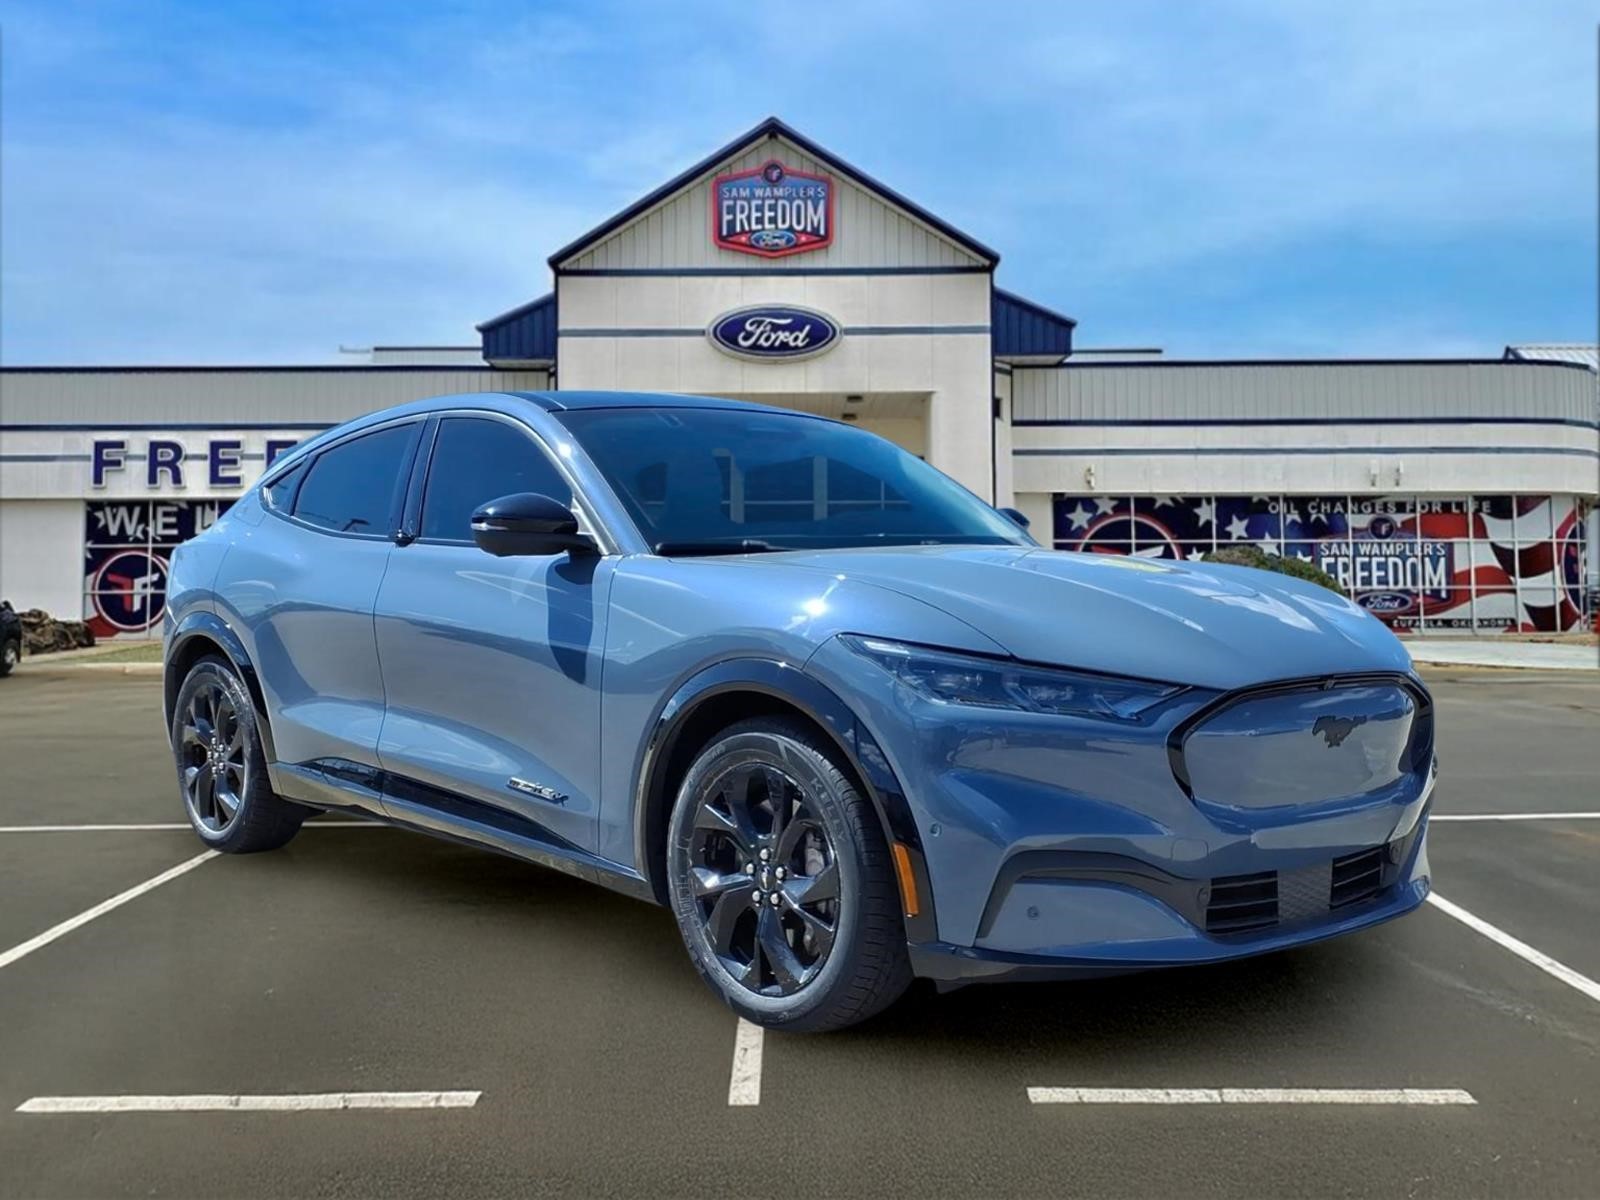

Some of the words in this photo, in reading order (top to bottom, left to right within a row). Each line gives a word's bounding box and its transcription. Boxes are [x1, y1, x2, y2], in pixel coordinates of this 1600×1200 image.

[722, 187, 750, 198] SAM
[722, 199, 825, 236] FREEDOM
[759, 235, 788, 248] Ford
[737, 316, 811, 348] Ford
[1268, 502, 1298, 514] OIL
[1308, 501, 1397, 514] CHANGES
[1405, 501, 1443, 513] FOR
[1451, 501, 1492, 513] LIFE
[1320, 542, 1354, 556] SAM
[1365, 595, 1401, 609] Ford
